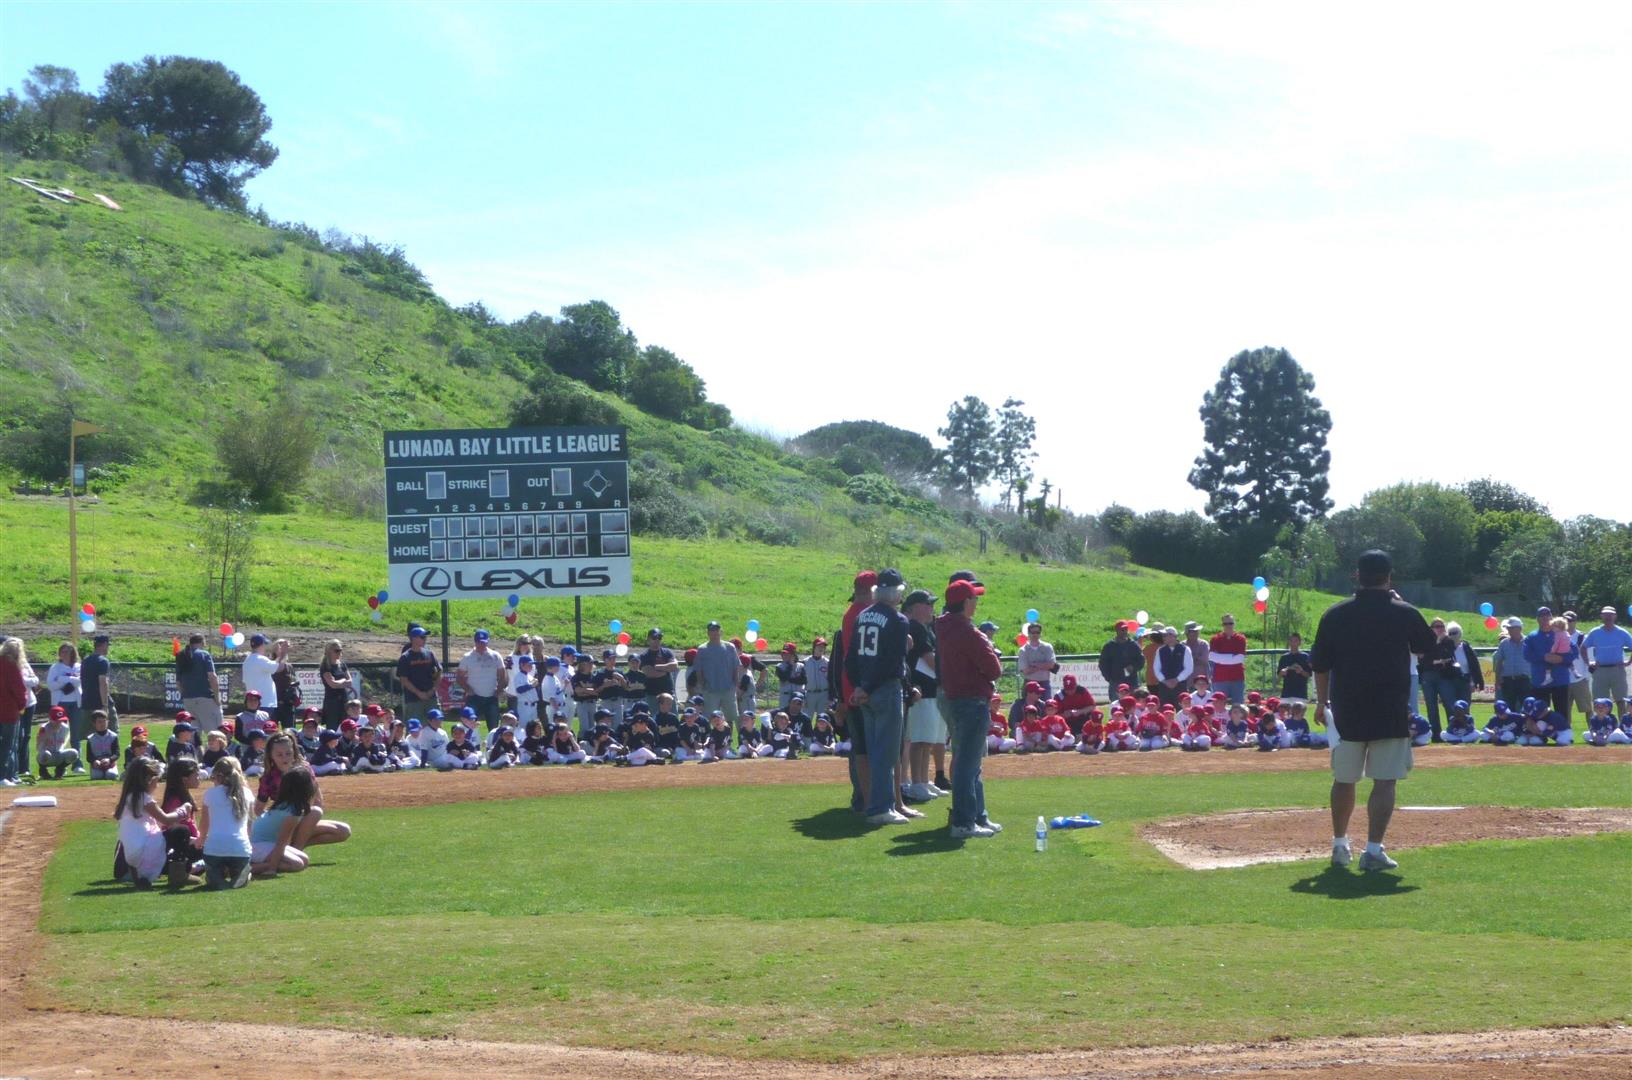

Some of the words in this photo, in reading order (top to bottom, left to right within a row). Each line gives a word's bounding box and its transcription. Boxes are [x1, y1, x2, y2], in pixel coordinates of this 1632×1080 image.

[388, 438, 455, 458] LUNADA
[460, 437, 491, 456] BAY
[496, 436, 552, 455] LITTLE
[557, 434, 621, 453] LEAGUE
[396, 480, 424, 491] BALL
[448, 479, 488, 490] STRIKE
[527, 477, 550, 487] OUT
[452, 504, 459, 512] 2
[469, 504, 476, 512] 3
[487, 503, 493, 511] 4
[504, 502, 511, 510] 5
[522, 502, 529, 510] 6
[557, 501, 564, 509] 8
[614, 499, 621, 508] R
[389, 524, 428, 534] GUEST
[393, 545, 429, 556] HOME
[454, 566, 611, 591] LEXUS
[858, 625, 879, 656] 13
